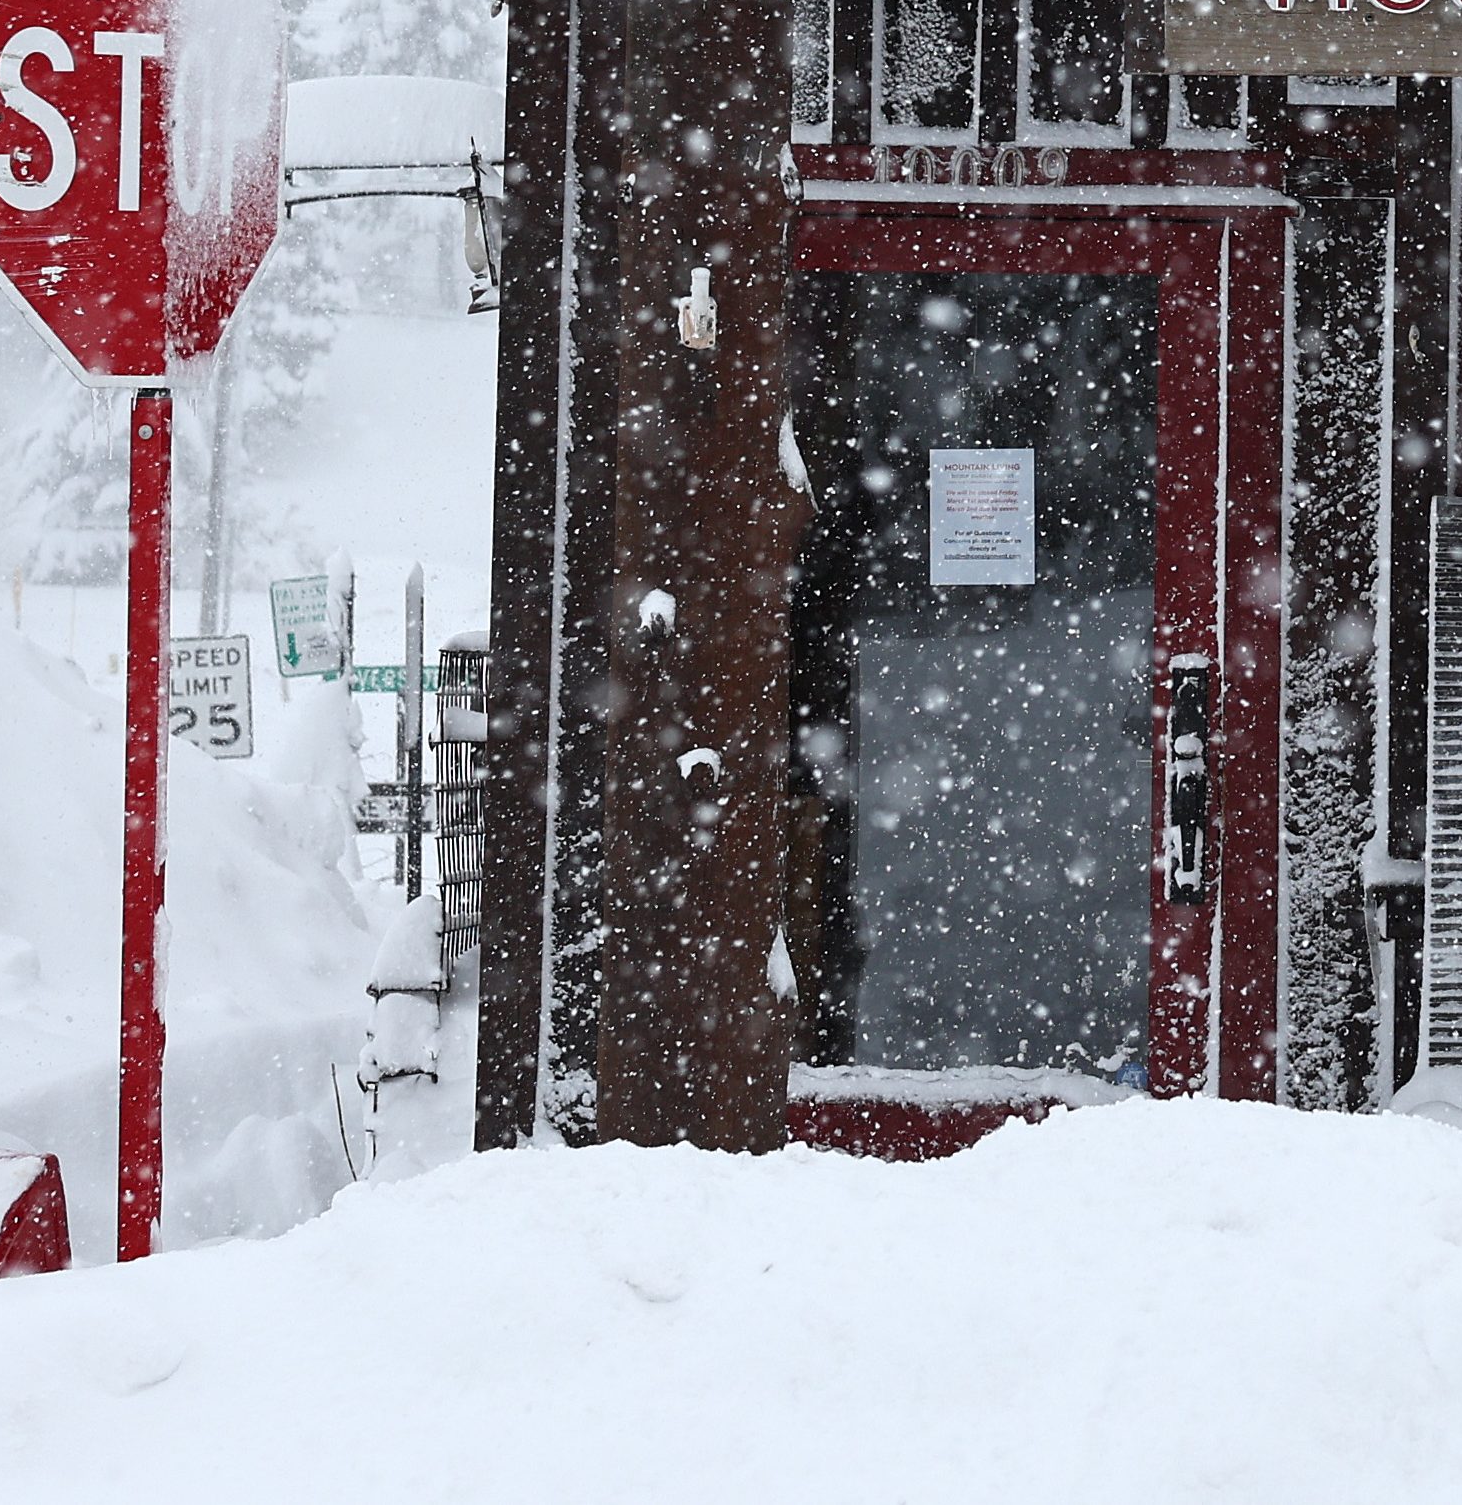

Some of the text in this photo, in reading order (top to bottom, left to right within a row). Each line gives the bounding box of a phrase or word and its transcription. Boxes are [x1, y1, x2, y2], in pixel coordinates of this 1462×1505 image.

[873, 146, 1069, 186] 10009
[944, 463, 991, 471] MOUNTAIN
[170, 647, 242, 669] PEED
[171, 676, 233, 696] LIMIT
[169, 701, 241, 747] 25
